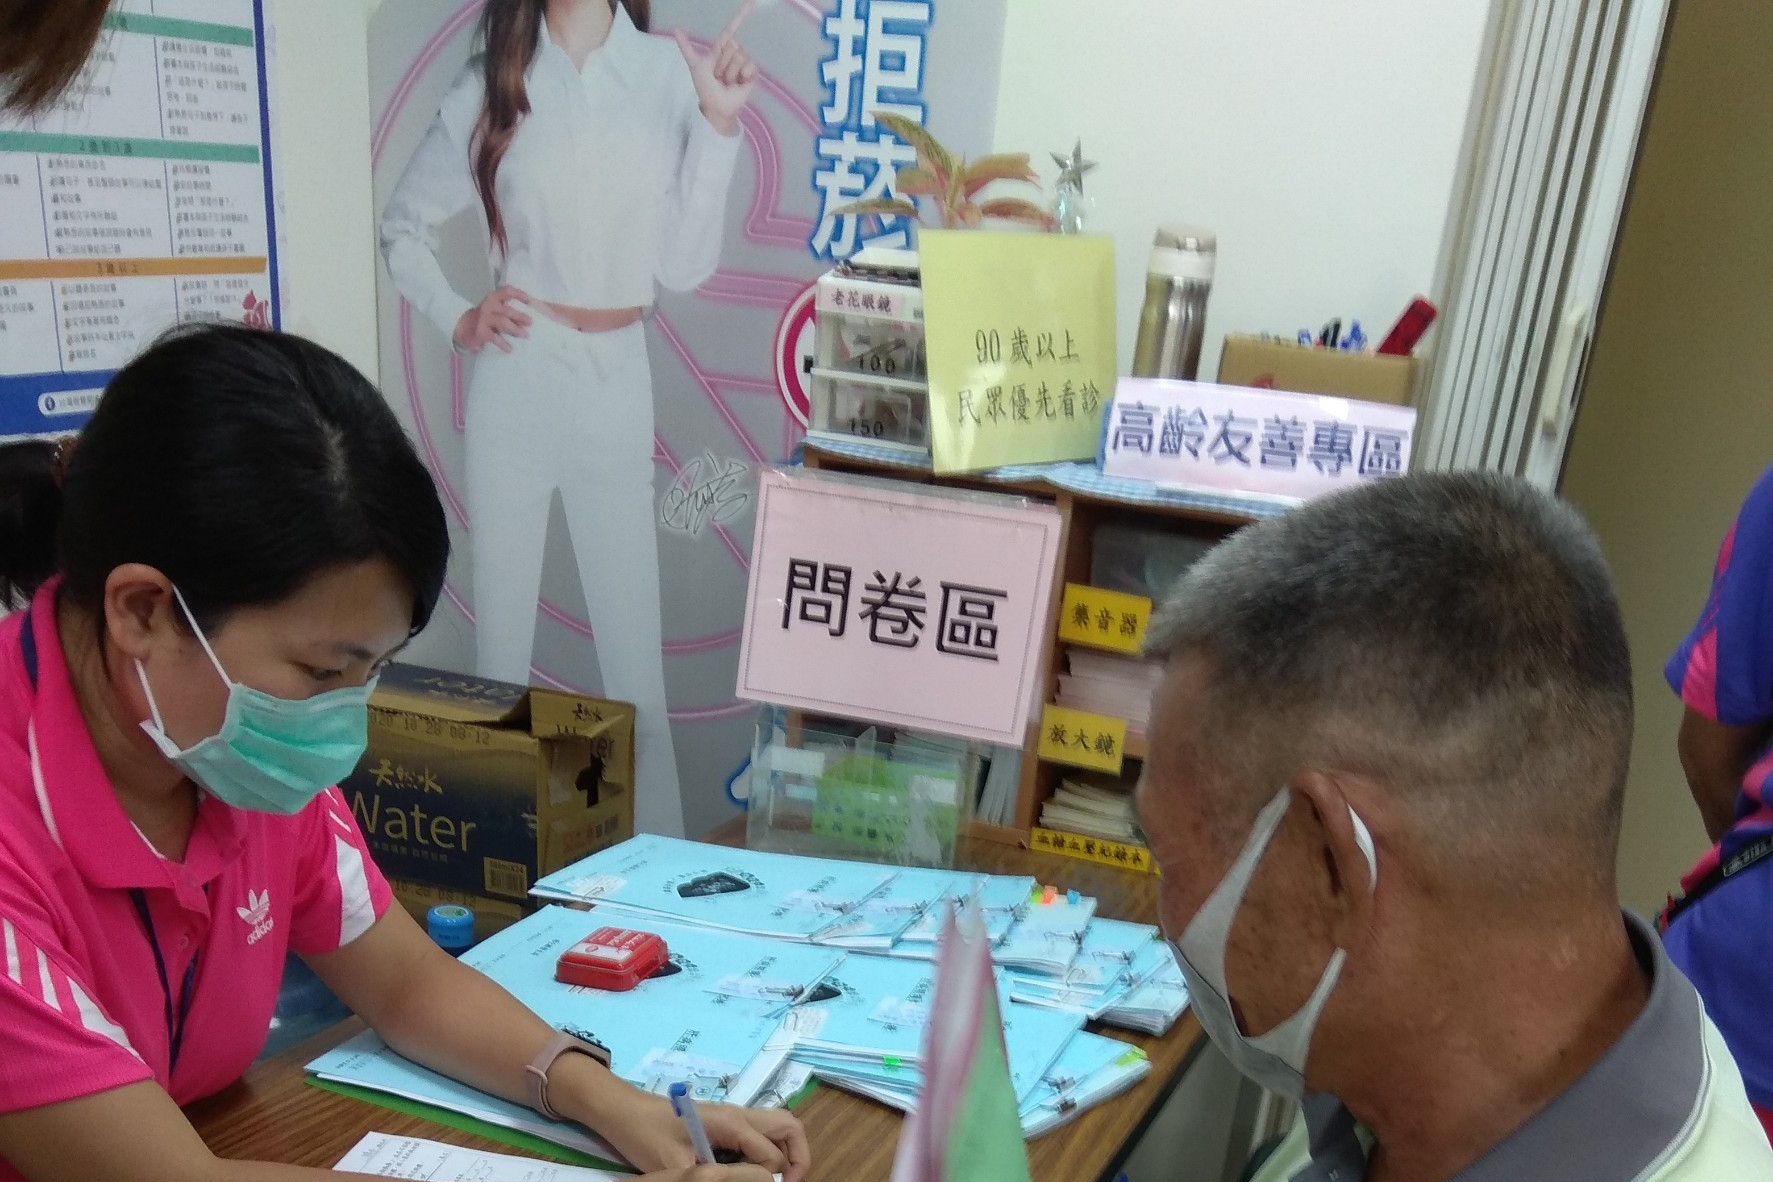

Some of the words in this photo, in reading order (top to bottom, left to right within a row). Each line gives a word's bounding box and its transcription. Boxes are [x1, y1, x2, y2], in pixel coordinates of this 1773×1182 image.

[812, 0, 930, 258] 拒菸
[830, 288, 892, 313] 老花眼鏡
[858, 353, 896, 374] 100
[958, 379, 1100, 426] 民眾優先看診
[849, 417, 884, 437] 150
[1112, 400, 1409, 476] 高齡友善專區
[781, 557, 1009, 661] 問卷區
[247, 916, 274, 945] adidas
